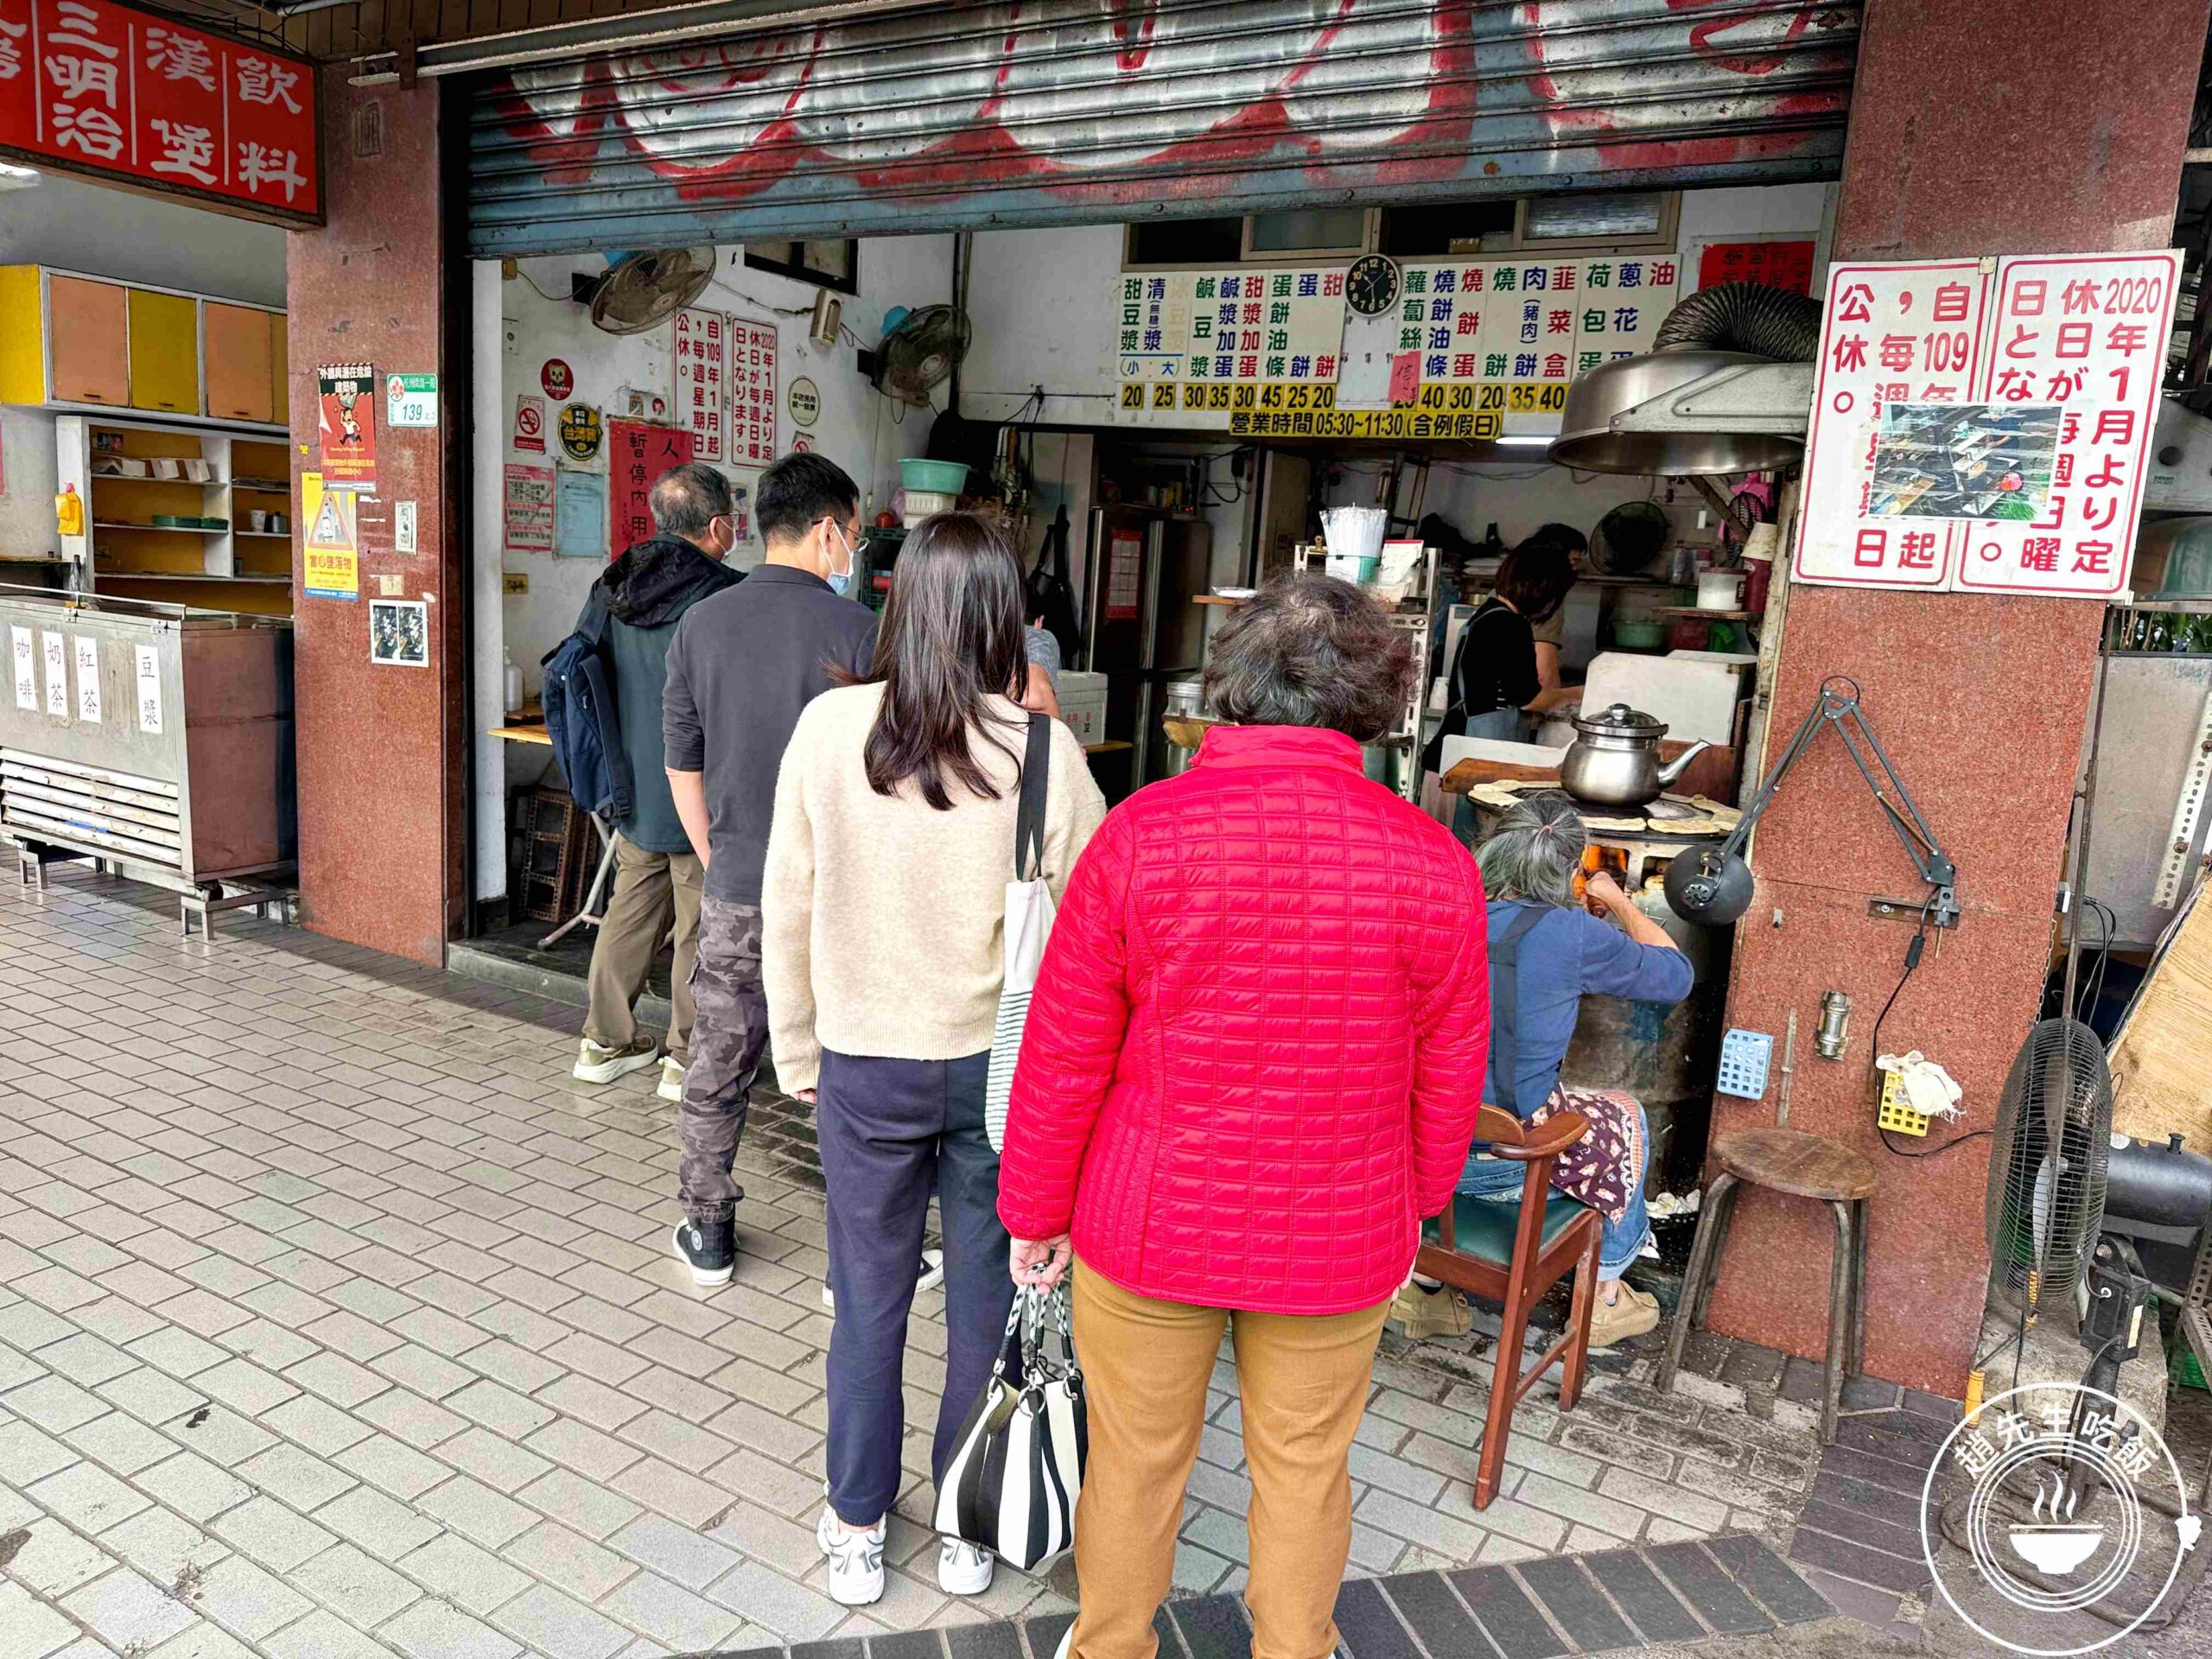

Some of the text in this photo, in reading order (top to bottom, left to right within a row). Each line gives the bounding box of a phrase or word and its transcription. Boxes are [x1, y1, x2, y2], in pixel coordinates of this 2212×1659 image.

[145, 27, 218, 186] 漢堡
[236, 56, 308, 203] 飲料
[1352, 270, 1362, 280] 10
[1359, 263, 1368, 272] 11
[1369, 258, 1378, 268] 12
[1382, 262, 1387, 270] 1
[1388, 269, 1394, 278] 2
[1649, 261, 1675, 286] 油
[1349, 282, 1356, 290] 9
[1386, 291, 1392, 300] 4
[1390, 280, 1396, 289] 3
[1352, 293, 1358, 302] 8
[1360, 300, 1366, 309] 7
[1378, 299, 1385, 308] 5
[1400, 270, 1427, 349] 蘿蔔絲
[1121, 277, 1142, 351] 甜豆漿
[1266, 274, 1293, 378] 蛋餅油條
[1290, 273, 1319, 378] 蛋餅
[1314, 273, 1344, 378] 甜餅
[1426, 269, 1456, 378] 燒餅油條
[1452, 268, 1484, 378] 燒餅蛋
[1484, 267, 1516, 377] 燒餅
[1542, 265, 1577, 377] 韭菜盒
[1577, 264, 1611, 375] 荷包蛋
[1190, 276, 1216, 378] 鹹豆漿
[1214, 276, 1241, 378] 鹹漿加蛋
[1238, 276, 1264, 378] 甜漿加蛋
[1124, 385, 1141, 407] 20
[1154, 385, 1173, 407] 25
[1185, 385, 1204, 408] 30
[1210, 385, 1229, 408] 35
[1235, 385, 1254, 408] 30
[1262, 385, 1281, 408] 45
[1288, 385, 1308, 409] 25
[1313, 385, 1333, 409] 20
[1421, 385, 1444, 410] 40
[1450, 385, 1472, 410] 30
[1480, 385, 1503, 410] 20
[1512, 385, 1535, 410] 35
[1540, 385, 1565, 410] 40
[403, 404, 423, 420] 139
[2070, 276, 2162, 574] 2020年1月より定
[629, 432, 648, 535] 暫停內用
[16, 637, 33, 701] 咖啡
[47, 641, 64, 708] 奶茶
[79, 646, 98, 715] 紅茶
[140, 656, 159, 726] 豆漿
